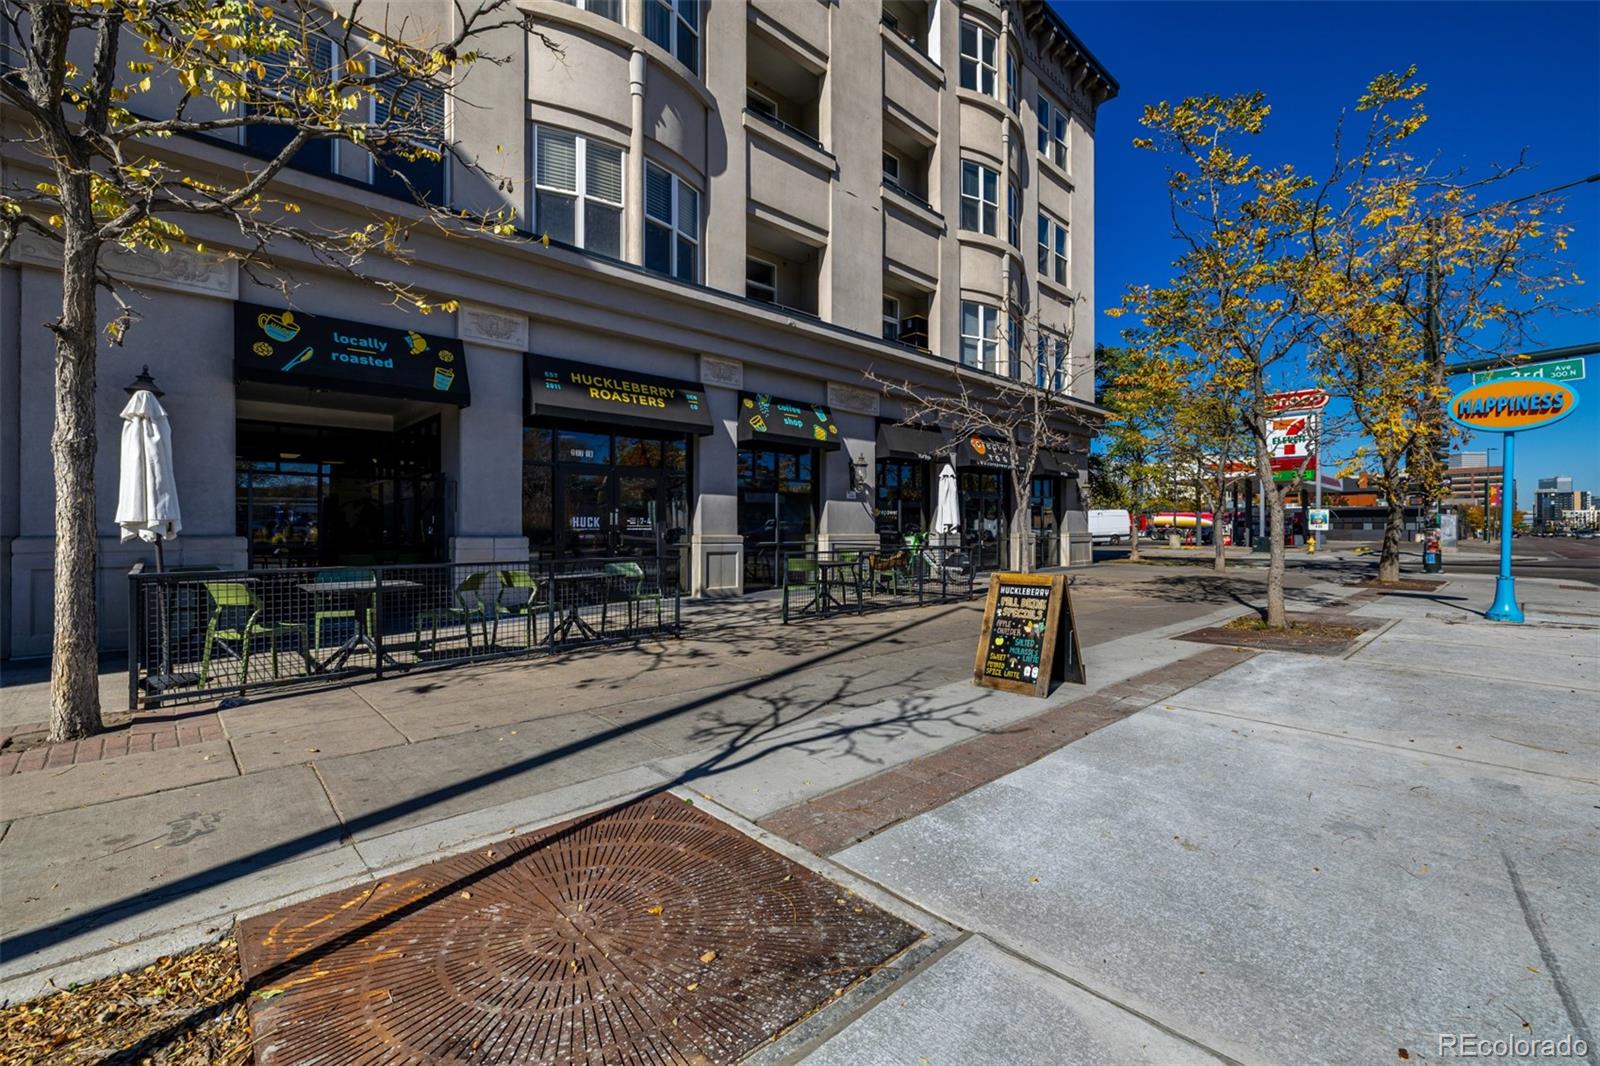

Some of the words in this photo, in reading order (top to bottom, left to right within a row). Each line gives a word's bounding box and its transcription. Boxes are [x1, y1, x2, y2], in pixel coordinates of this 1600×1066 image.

[333, 332, 388, 351] locally
[331, 352, 394, 368] roasted
[570, 372, 675, 399] HUCKLEBERRY
[589, 387, 665, 408] ROASTERS
[1457, 391, 1566, 419] HAPPINESS
[572, 516, 600, 528] HUCK
[1000, 586, 1050, 597] HUCKLEBERRY
